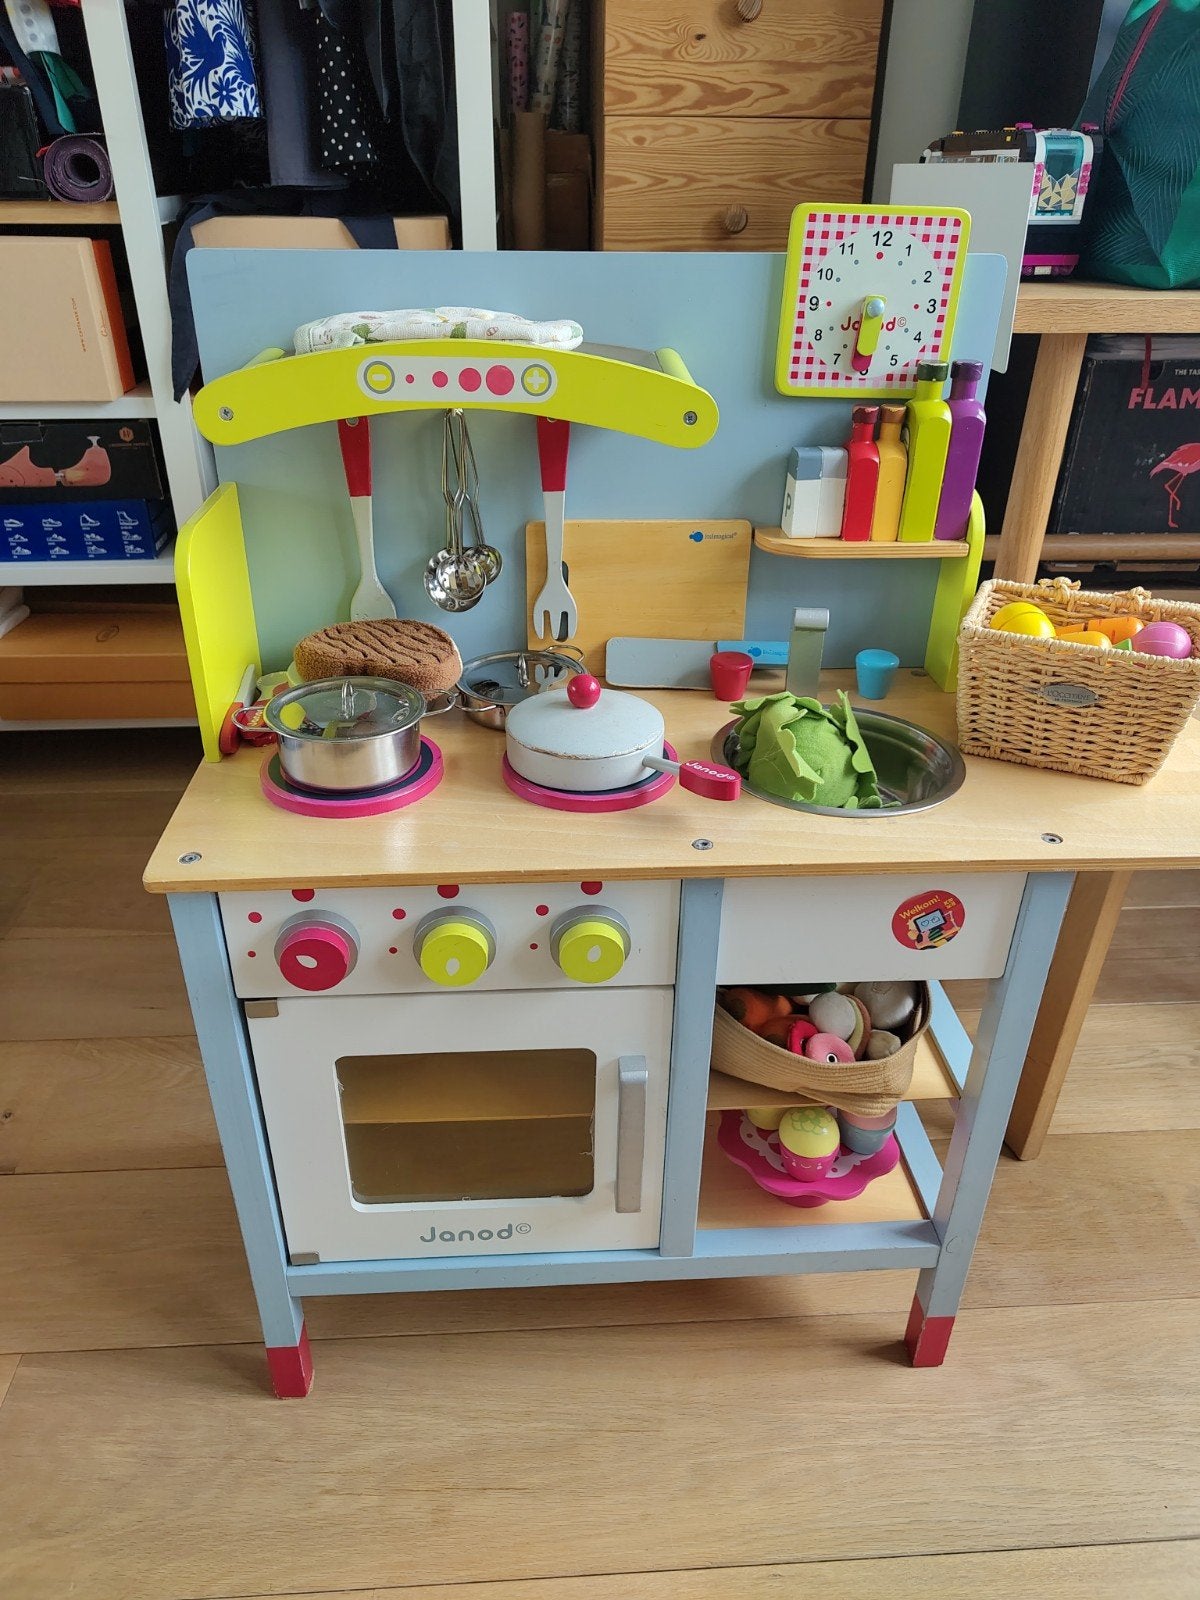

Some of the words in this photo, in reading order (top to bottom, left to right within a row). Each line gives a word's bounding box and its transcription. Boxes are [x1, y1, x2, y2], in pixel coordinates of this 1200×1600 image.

[872, 230, 893, 247] 12
[839, 243, 855, 255] 11
[905, 244, 912, 256] 1
[817, 268, 834, 281] 10
[923, 270, 932, 283] 2
[809, 296, 820, 311] 9
[926, 298, 937, 314] 3
[814, 328, 823, 341] 8
[913, 331, 922, 343] 4
[833, 353, 841, 365] 7
[889, 354, 898, 366] 5
[1174, 368, 1187, 376] THE
[1127, 387, 1200, 410] FLAM
[898, 895, 941, 920] Welkom!
